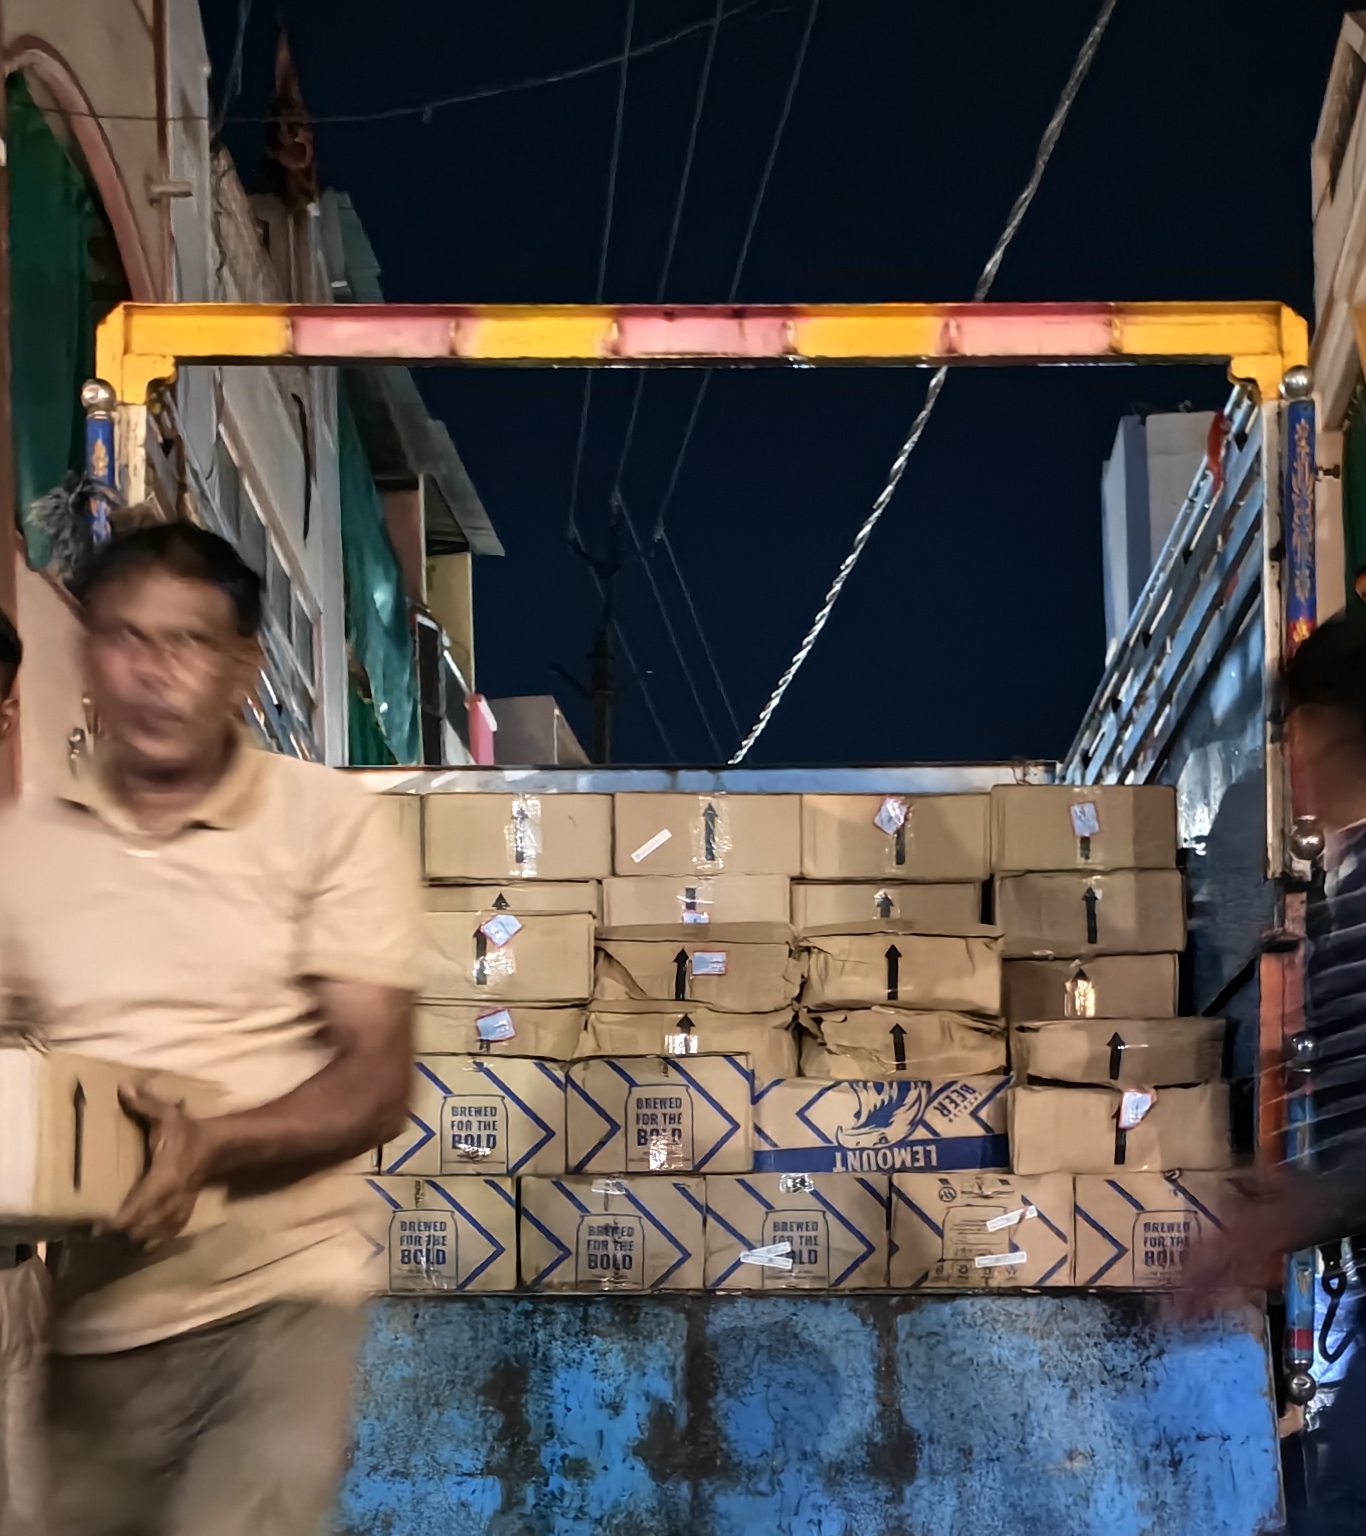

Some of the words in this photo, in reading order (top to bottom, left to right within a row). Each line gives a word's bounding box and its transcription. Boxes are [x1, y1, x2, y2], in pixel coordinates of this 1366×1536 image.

[636, 1097, 682, 1109] BREWED
[933, 1083, 976, 1118] BEER
[451, 1106, 497, 1117] BREWED
[636, 1112, 658, 1126] FOR
[662, 1112, 682, 1126] THE
[451, 1120, 473, 1131] FOR
[477, 1120, 498, 1131] THE
[833, 1144, 938, 1172] LEMOUNT
[400, 1220, 447, 1232] BREWED
[588, 1225, 634, 1237] BREWED
[773, 1221, 819, 1232] BREWED
[1143, 1222, 1190, 1234] BREWED
[400, 1235, 422, 1247] FOR
[426, 1234, 447, 1247] THE
[587, 1239, 609, 1251] FOR
[614, 1240, 634, 1252] THE
[798, 1235, 819, 1246] THE
[1143, 1236, 1165, 1248] FOR
[588, 1253, 633, 1270] BOLD
